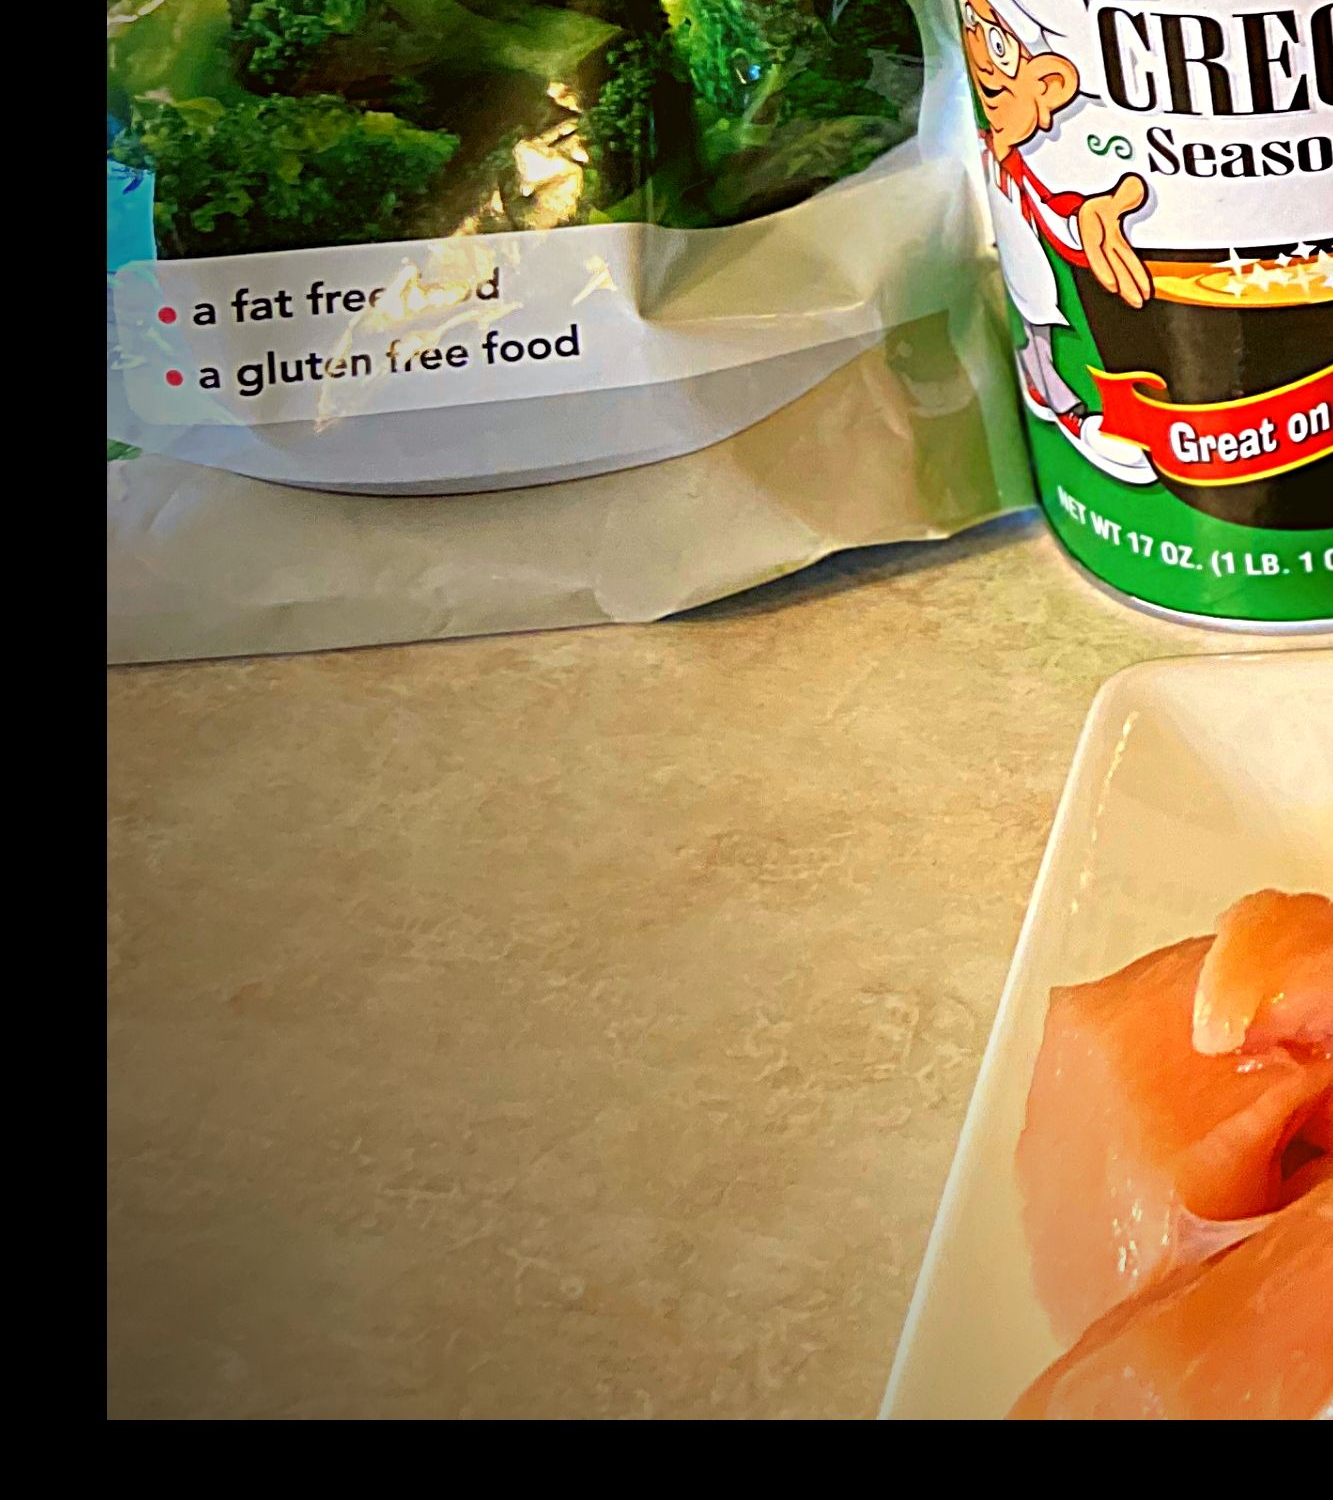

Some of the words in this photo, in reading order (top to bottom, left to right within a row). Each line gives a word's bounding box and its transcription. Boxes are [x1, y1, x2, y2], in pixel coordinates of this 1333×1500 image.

[193, 304, 216, 325] a
[231, 288, 293, 323] fat
[199, 369, 221, 389] a
[237, 350, 373, 398] gluten
[386, 339, 470, 373] free
[482, 323, 581, 365] food
[1170, 417, 1277, 464] Great
[1287, 401, 1330, 438] on
[1056, 485, 1088, 526] NET
[1091, 512, 1120, 545] WT
[1127, 530, 1153, 556] 17
[1160, 542, 1204, 572] OZ.
[1212, 551, 1234, 578] (1
[1245, 552, 1291, 576] LB.
[1300, 550, 1314, 572] 1
